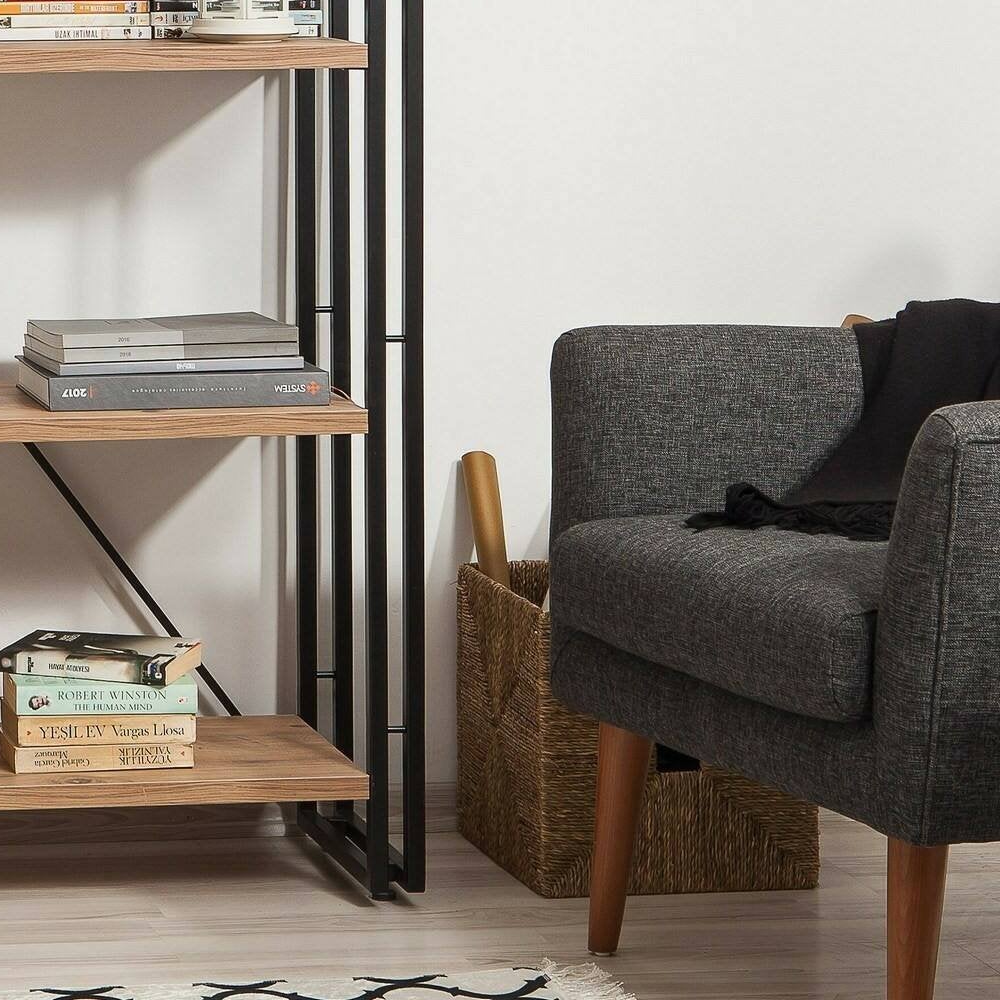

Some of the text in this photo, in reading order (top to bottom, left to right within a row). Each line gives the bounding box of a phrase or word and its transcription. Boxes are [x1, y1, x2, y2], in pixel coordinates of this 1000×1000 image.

[55, 30, 70, 38] UZAK
[62, 388, 87, 398] 2017
[274, 384, 306, 394] SYSTEM
[57, 689, 167, 700] ROBERT WINSTON
[73, 702, 153, 711] THE HUMAN MIND
[39, 723, 185, 741] YEŞİL EV Vargas Llosa
[34, 749, 68, 759] Marquez
[118, 747, 171, 757] YALNIZLIK
[59, 758, 90, 768] Gabriel
[119, 756, 172, 766] YÜZYILLIK
